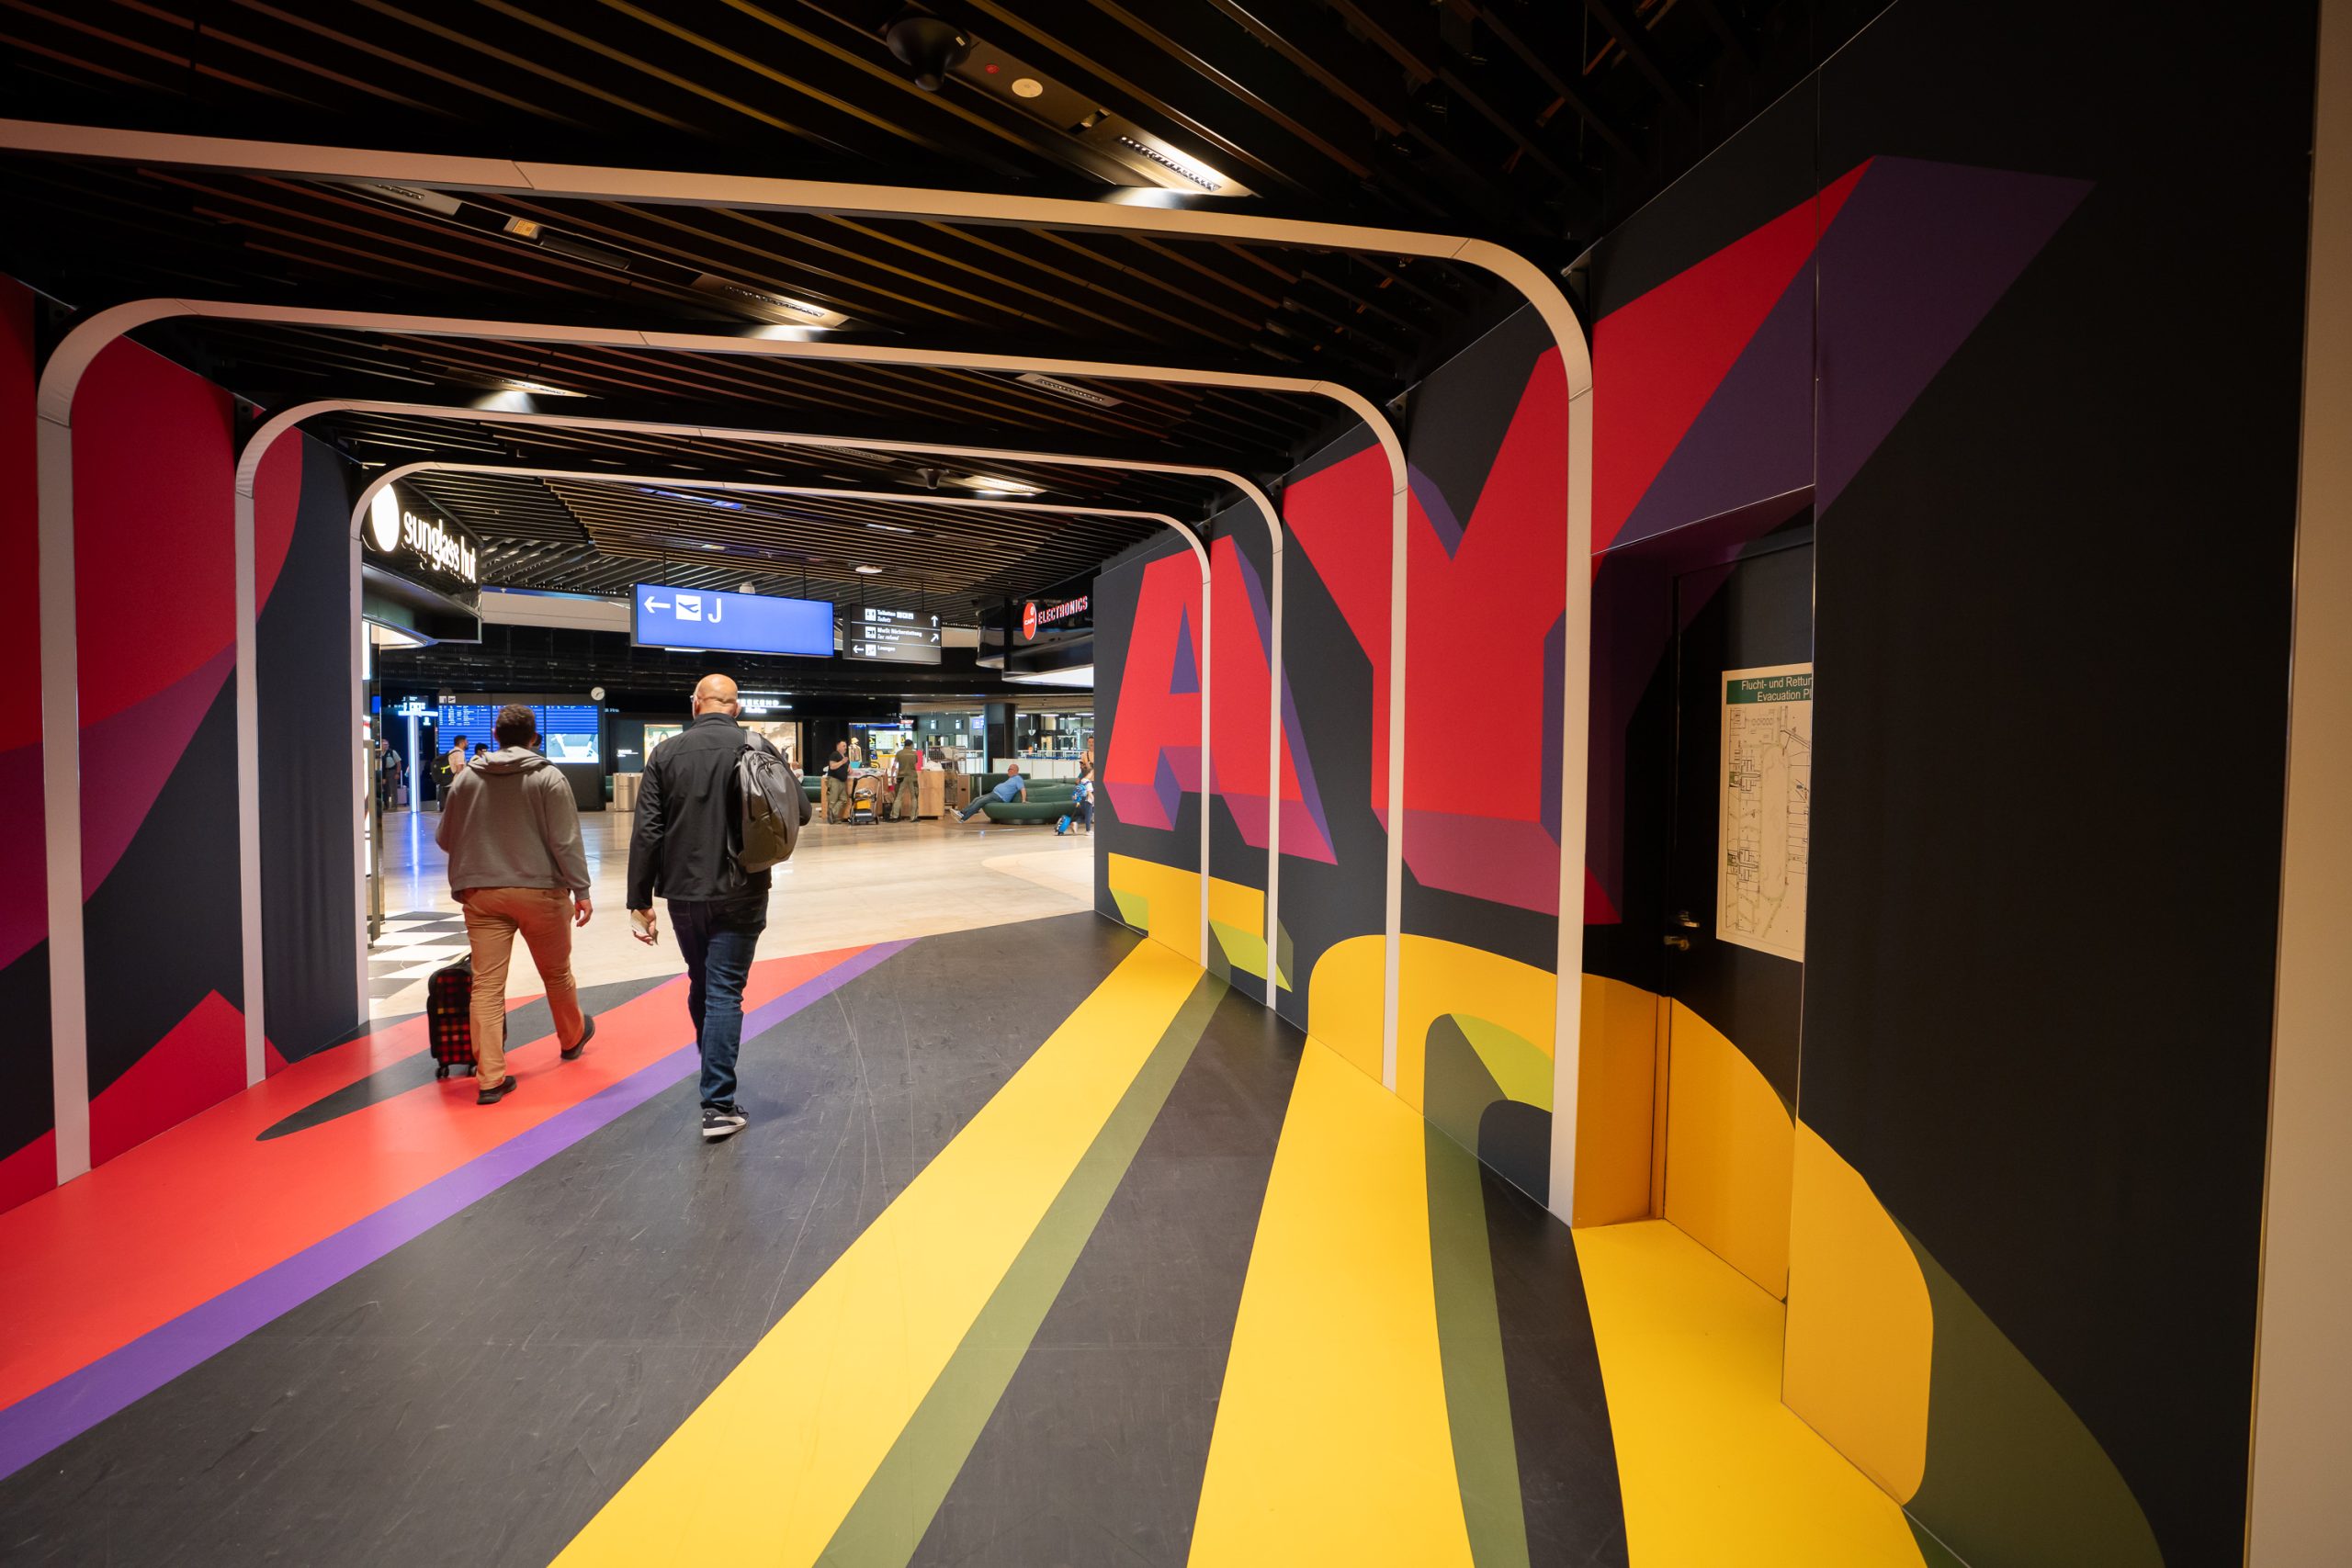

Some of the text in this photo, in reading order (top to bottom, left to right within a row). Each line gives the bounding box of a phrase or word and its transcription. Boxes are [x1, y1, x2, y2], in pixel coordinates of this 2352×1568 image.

[403, 511, 477, 583] sunglass hut
[707, 598, 722, 623] J
[1038, 595, 1088, 625] ELECTRONICS
[1741, 680, 1767, 691] Flucht-
[1769, 679, 1783, 689] und
[1757, 689, 1801, 702] Evacuation
